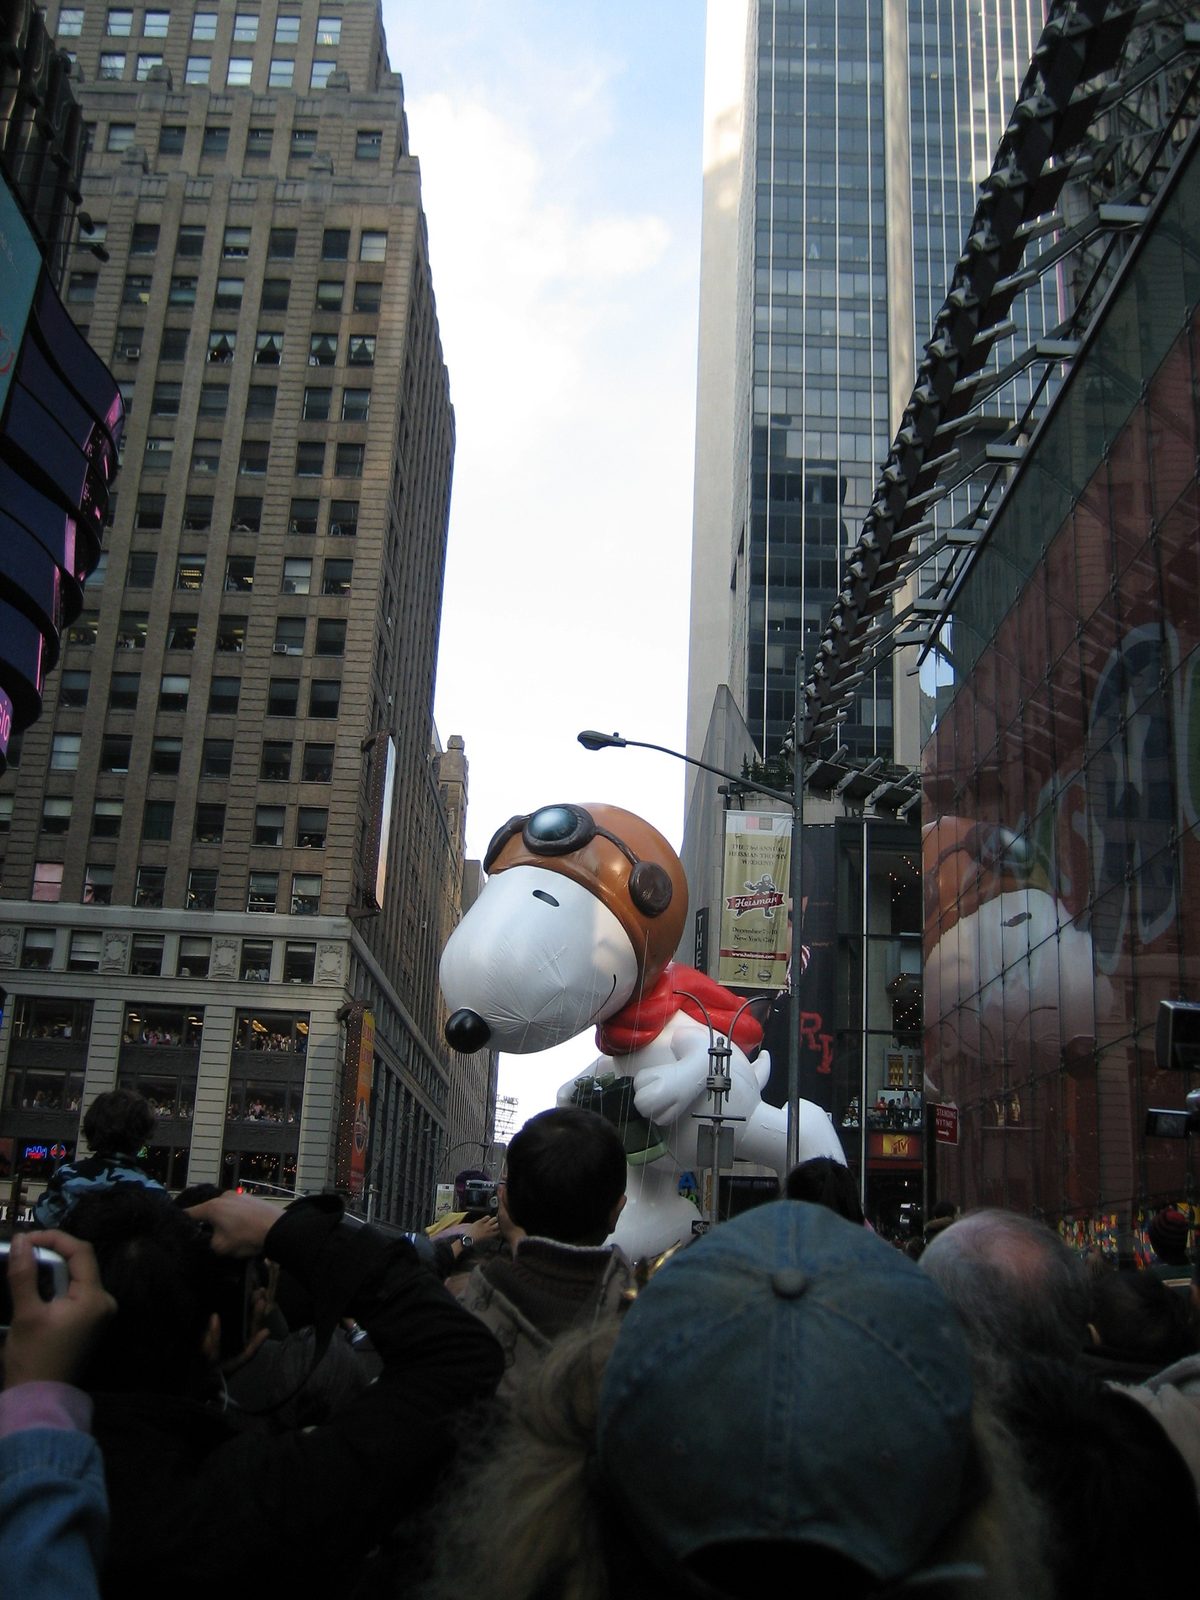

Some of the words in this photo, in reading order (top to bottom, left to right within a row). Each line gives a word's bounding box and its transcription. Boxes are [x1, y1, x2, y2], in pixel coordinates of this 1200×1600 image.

[735, 897, 777, 908] Heisman
[732, 927, 761, 935] December
[936, 1108, 957, 1120] STANDING
[935, 1118, 953, 1129] NYTIME
[883, 1134, 912, 1155] MTV
